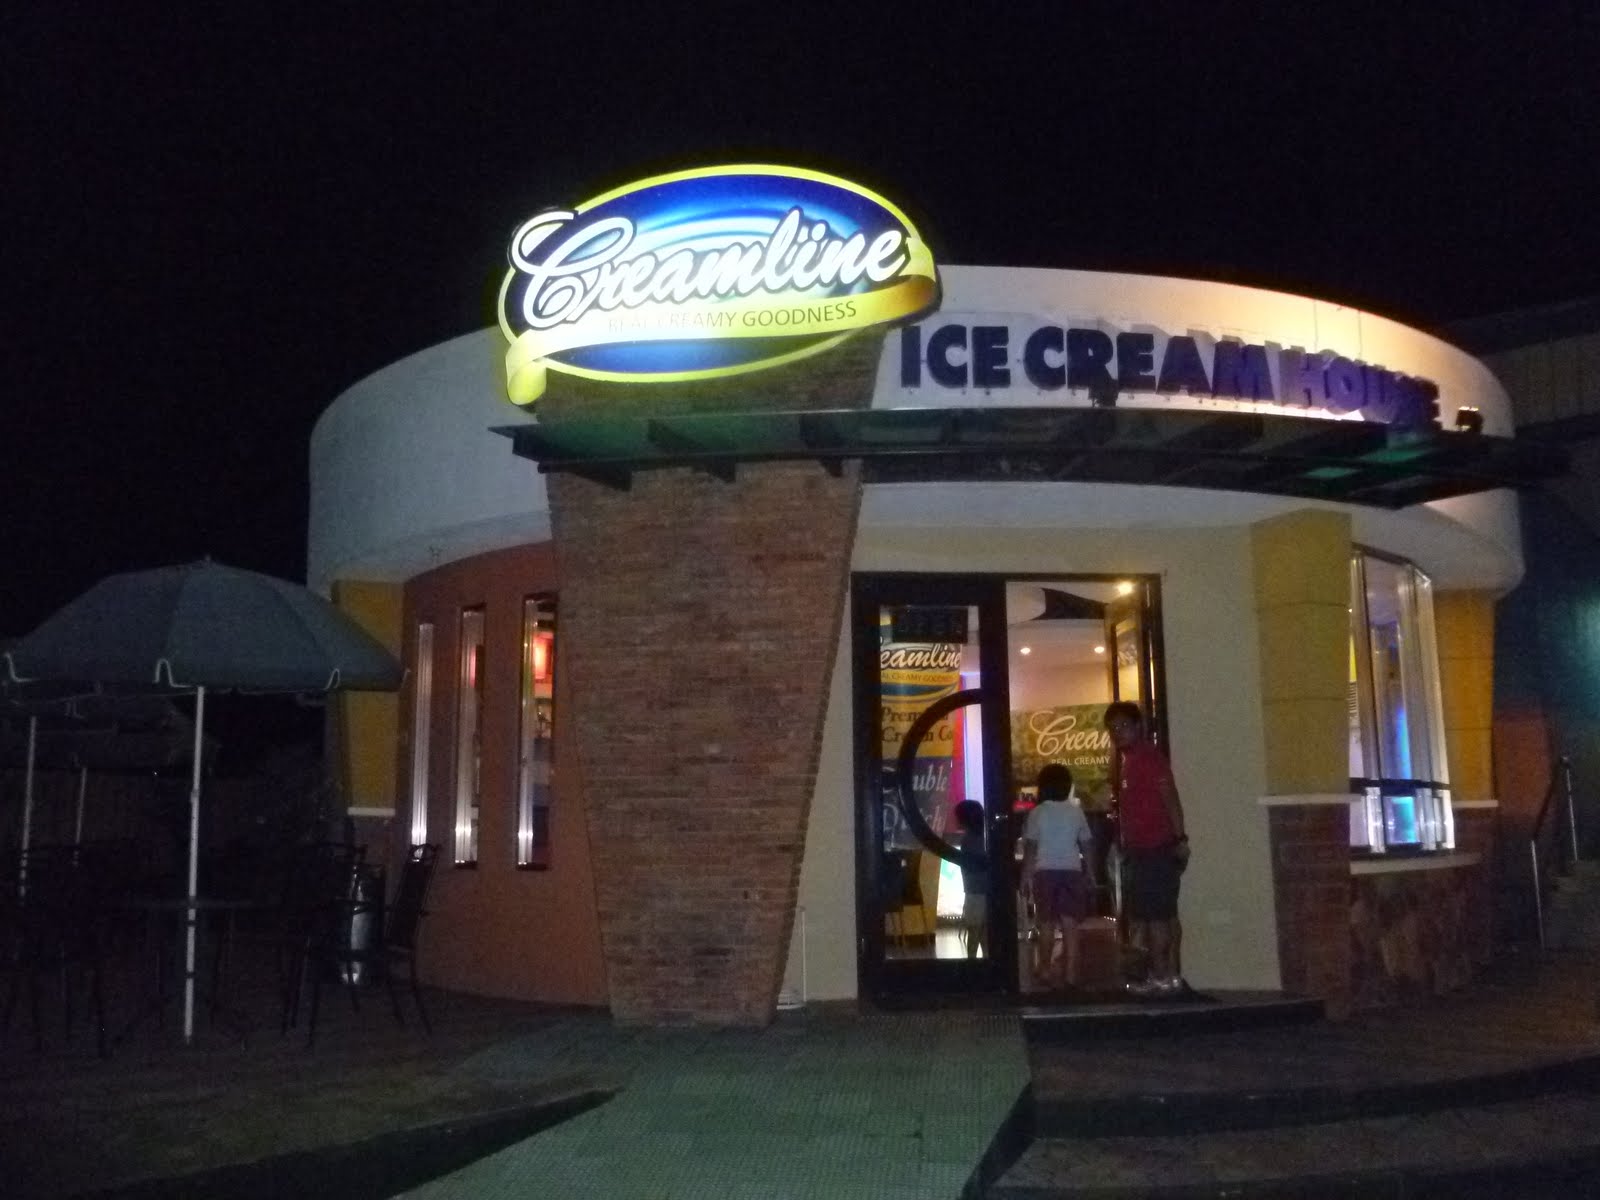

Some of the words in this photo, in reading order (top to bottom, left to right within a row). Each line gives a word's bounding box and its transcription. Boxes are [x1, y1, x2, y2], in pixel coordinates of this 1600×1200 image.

[510, 207, 907, 328] Creamline
[656, 310, 736, 330] CREAMY
[742, 300, 857, 327] GOODNESS
[900, 325, 1010, 389] ICE
[1023, 326, 1275, 402] CREAM
[1279, 348, 1439, 428] HOUE
[881, 642, 961, 668] eamline
[1074, 756, 1111, 766] CREAMY
